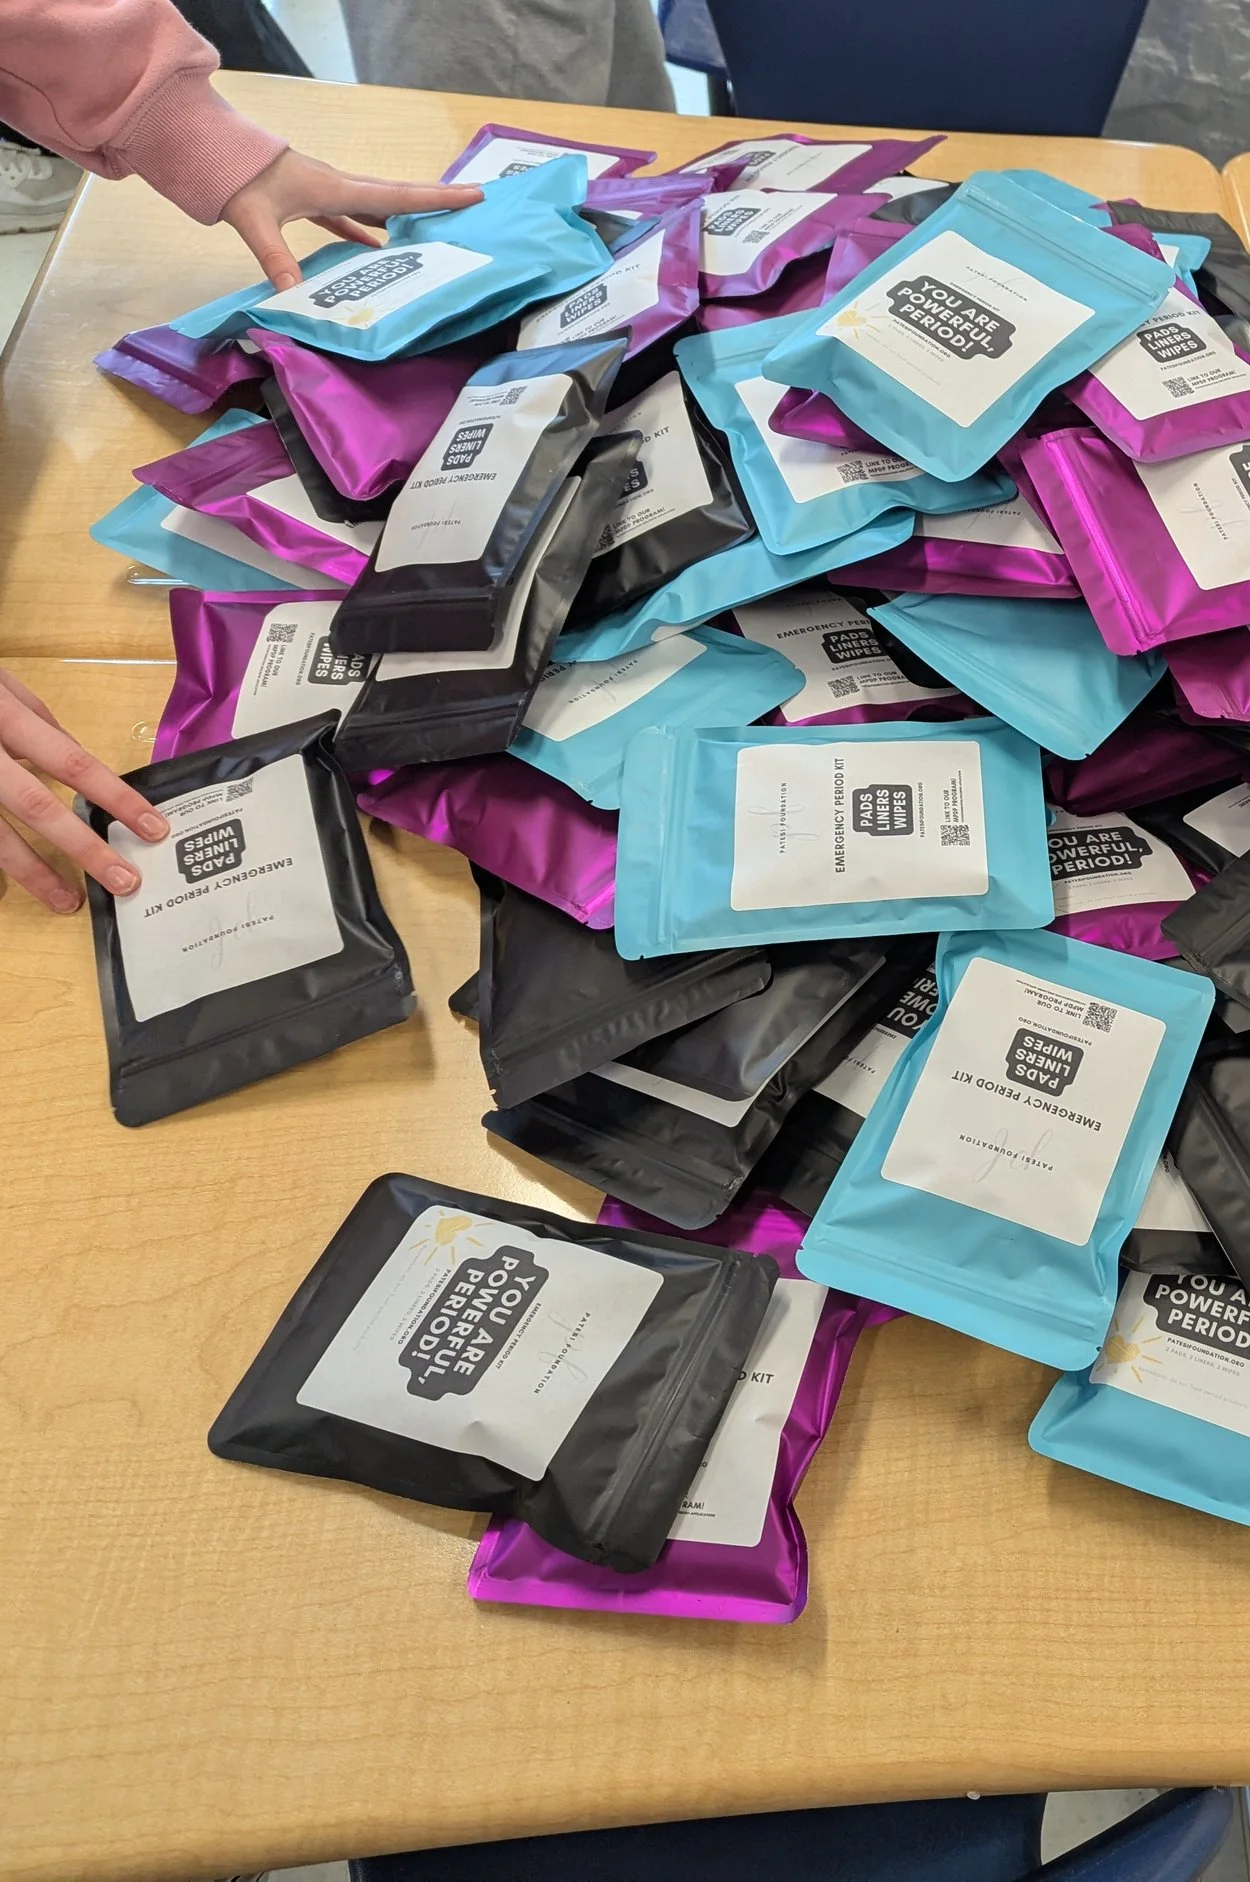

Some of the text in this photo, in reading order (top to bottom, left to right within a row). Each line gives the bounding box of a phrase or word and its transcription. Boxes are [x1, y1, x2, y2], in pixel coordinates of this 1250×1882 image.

[319, 272, 357, 295] YOU
[360, 258, 390, 278] ARE
[326, 255, 414, 303] POWERFUL,
[352, 264, 413, 297] PERIOD!
[564, 289, 603, 317] LINERS
[568, 285, 600, 309] PADS
[921, 281, 1000, 332] YOU ARE
[566, 300, 602, 323] WIPES
[897, 287, 995, 352] POWERFUL,
[1152, 311, 1185, 324] PERIOD
[899, 304, 974, 353] PERIOD!
[1144, 326, 1179, 341] PADS
[1148, 332, 1192, 350] LINERS
[1157, 341, 1198, 358] WIPES
[457, 428, 486, 441] WIPES
[654, 426, 670, 438] KIT
[447, 453, 473, 465] PADS
[450, 440, 482, 452] LINERS
[410, 472, 497, 489] EMERGENCY PERIOD KIT
[777, 622, 845, 639] EMERGENCY
[830, 632, 869, 642] PADS
[830, 639, 879, 652] LINERS
[836, 647, 881, 659] WIPES
[568, 677, 614, 704] FOUNDATION
[780, 782, 788, 826] FOUNDATION
[835, 758, 846, 873] EMERGENCY PERIOD KIT
[860, 792, 873, 827] PADS
[876, 789, 889, 830] LINERS
[894, 790, 906, 830] WIPES
[183, 838, 239, 865] LINERS
[184, 825, 235, 852] WIPES
[1048, 831, 1122, 849] OU ARE
[191, 853, 235, 877] PADS
[1048, 842, 1144, 864] OWERFUL,
[1052, 853, 1132, 875] PERIOD!
[144, 857, 293, 918] EMERGENCY PERIOD KIT
[182, 915, 274, 953] PATESI FOUNDATION
[1024, 987, 1061, 1005] PROGRAM!
[1036, 999, 1051, 1008] OUR
[1062, 1001, 1084, 1012] MPDP
[1067, 1009, 1081, 1020] LINK
[1018, 1016, 1092, 1046] PATESIFOUNDATION.ORG
[1014, 1048, 1072, 1077] LINERS
[1023, 1035, 1074, 1063] WIPES
[1015, 1064, 1059, 1089] PADS
[951, 1069, 1102, 1132] EMERGENCY PERIOD KIT
[959, 1134, 1053, 1171] PATESI FOUNDATION
[398, 1268, 451, 1345] PATESIFOUNDATION.ORG
[411, 1268, 485, 1361] PERIOD!
[417, 1254, 520, 1384] POWERFUL,
[453, 1275, 536, 1376] YOU ARE
[533, 1312, 591, 1395] PATESI FOUNDATION
[1166, 1337, 1245, 1368] PATESIFOUNDATION.ORG
[751, 1372, 775, 1384] KIT
